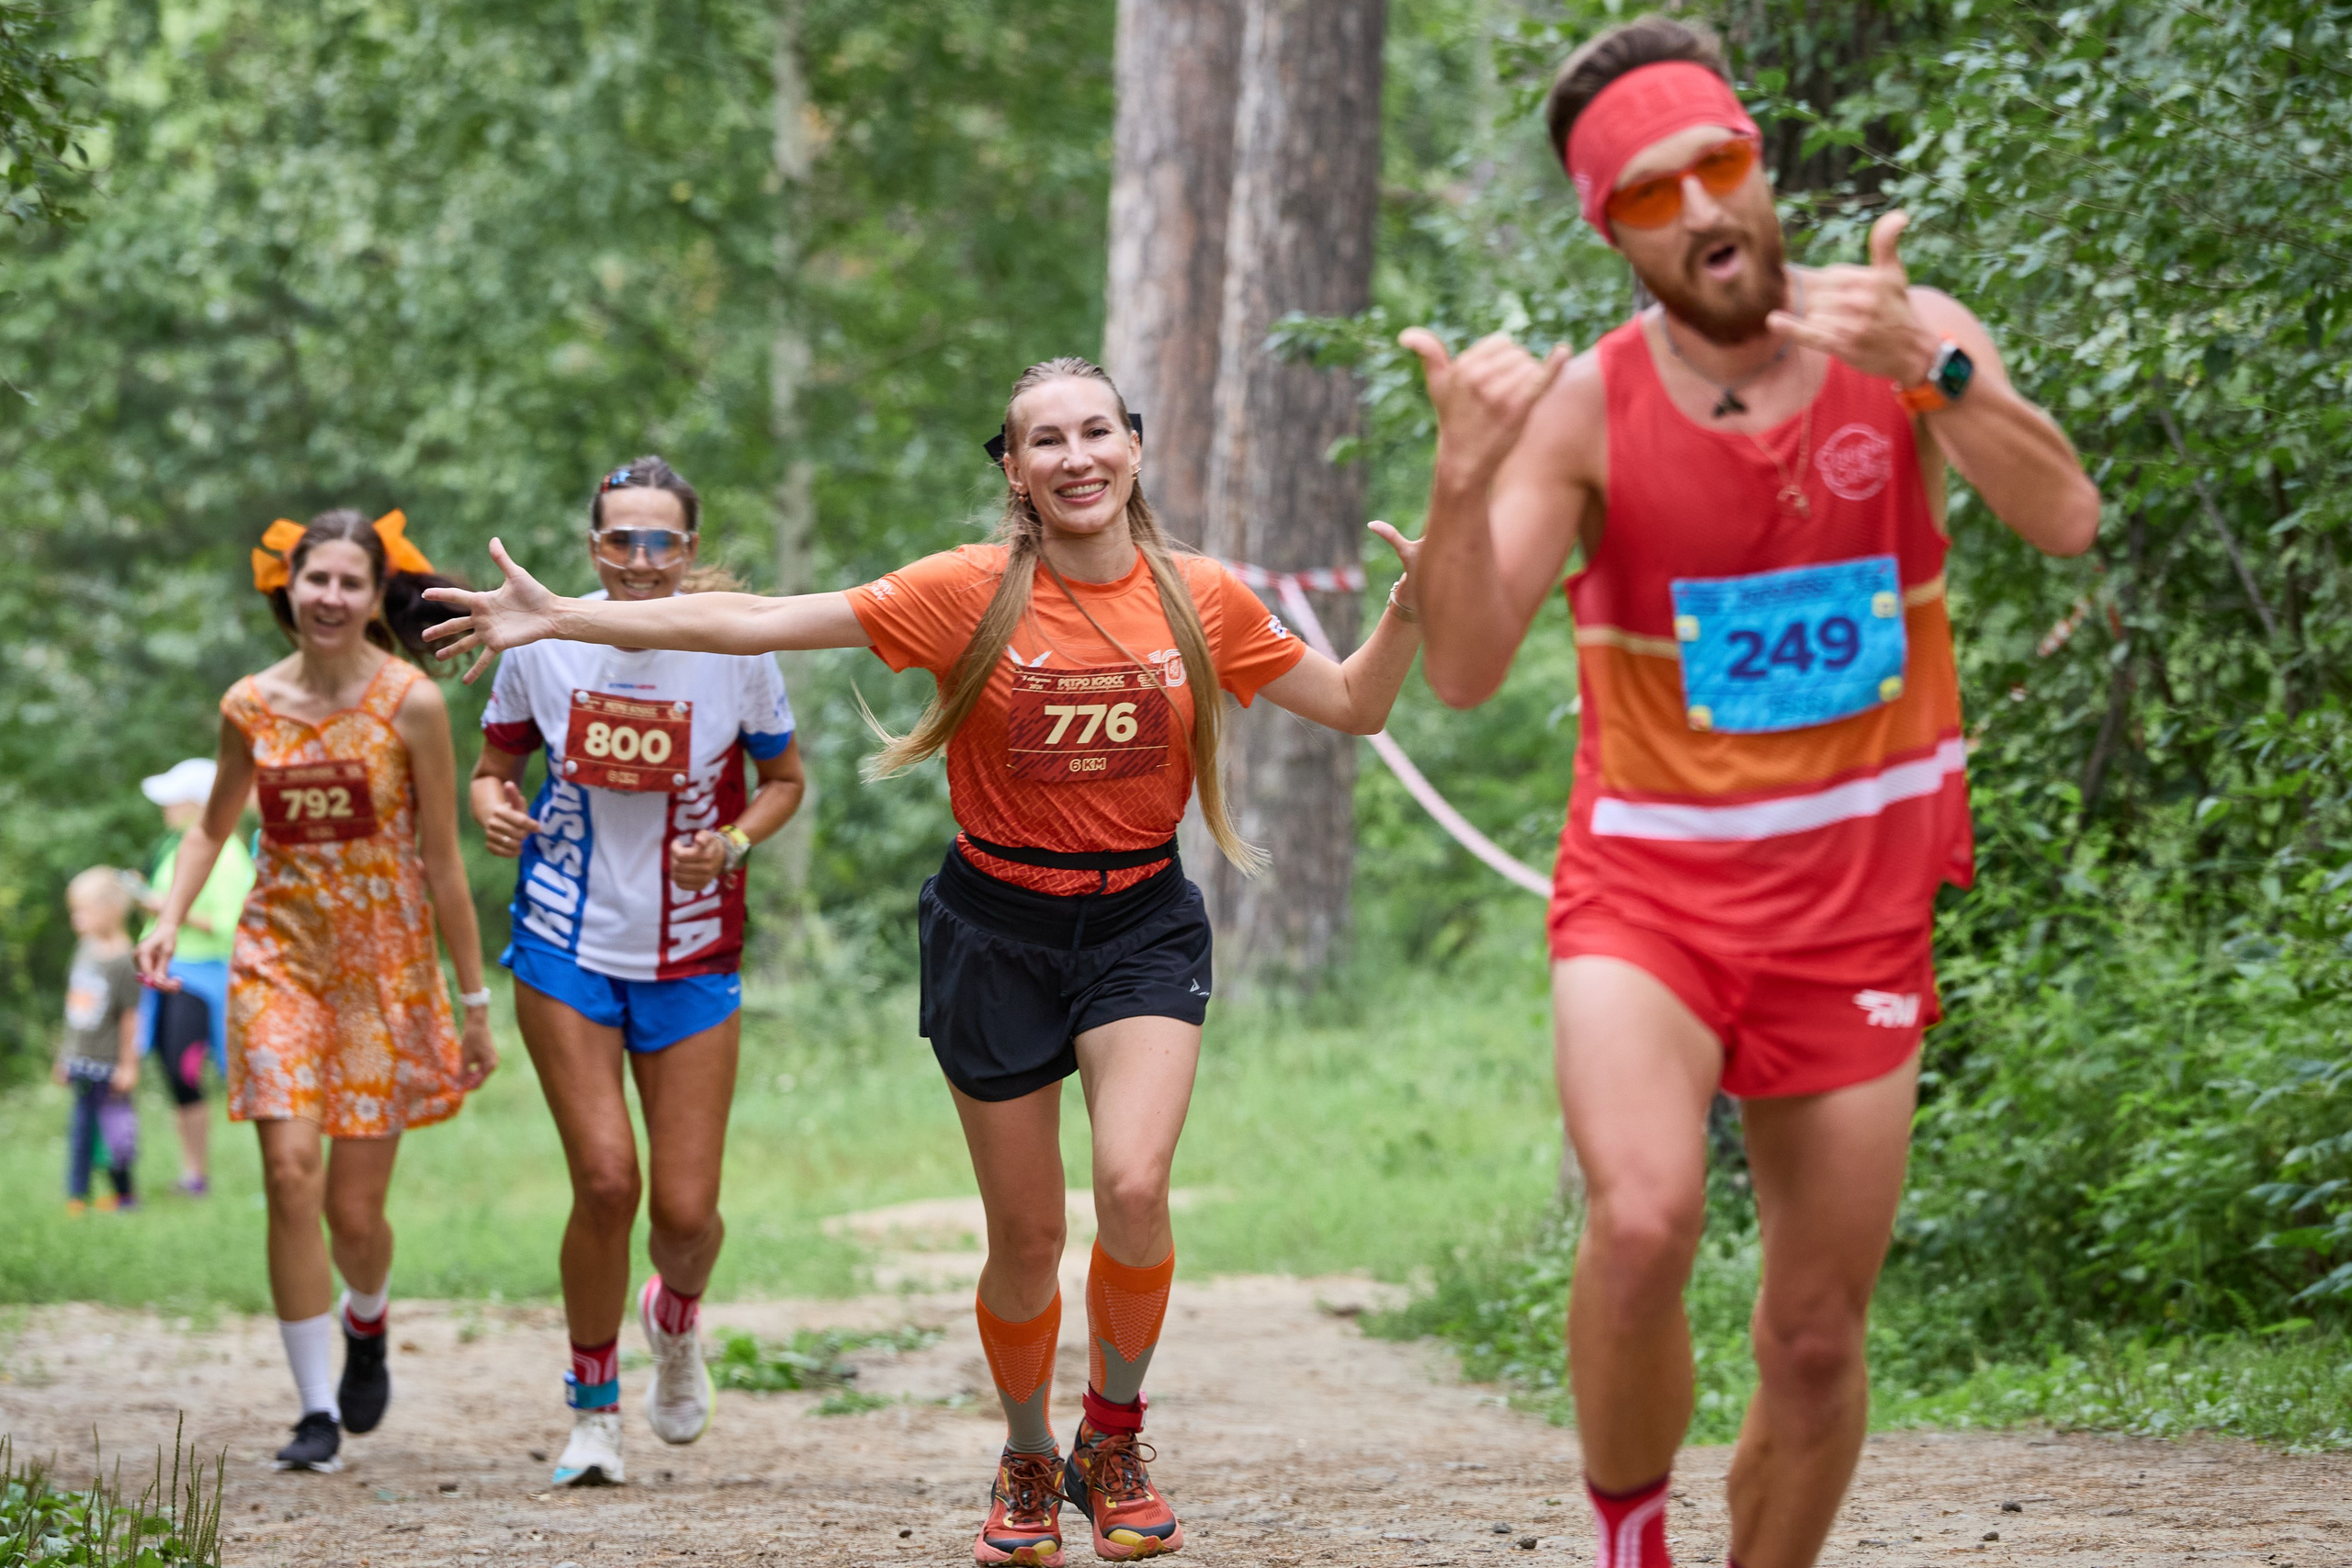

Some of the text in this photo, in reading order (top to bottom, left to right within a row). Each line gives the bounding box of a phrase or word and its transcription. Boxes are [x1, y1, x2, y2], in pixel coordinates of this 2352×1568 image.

[1726, 616, 1860, 679] 249
[584, 722, 672, 764] 800
[1044, 702, 1138, 745] 776
[1069, 758, 1082, 773] 6
[278, 786, 354, 821] 792
